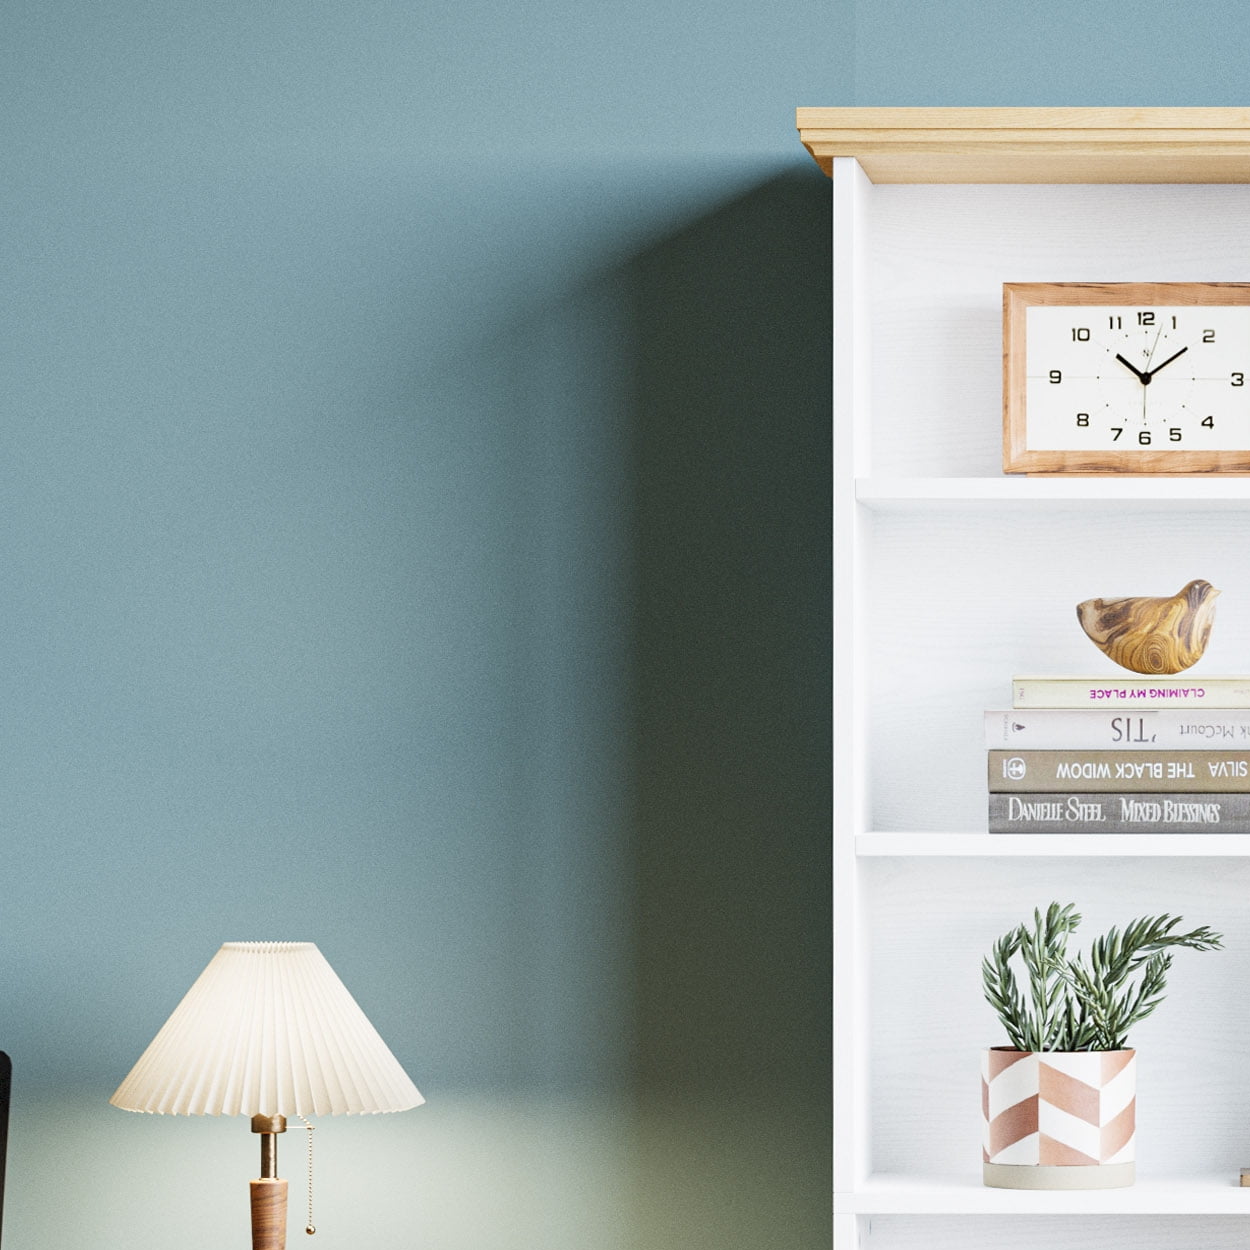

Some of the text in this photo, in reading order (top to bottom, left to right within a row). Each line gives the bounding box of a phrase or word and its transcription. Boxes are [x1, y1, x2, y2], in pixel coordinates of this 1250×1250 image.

[1109, 316, 1122, 329] 11
[1137, 312, 1155, 325] 12
[1171, 316, 1177, 329] 1
[1071, 328, 1090, 341] 10
[1202, 329, 1215, 343] 2
[1049, 370, 1061, 384] 9
[1231, 372, 1244, 386] 3
[1076, 413, 1089, 427] 8
[1201, 416, 1214, 429] 4
[1110, 428, 1123, 441] 7
[1138, 431, 1151, 445] 6
[1169, 428, 1182, 442] 5
[1089, 688, 1205, 699] CLAIMING MY PLACE
[1111, 717, 1157, 743] 'TIS
[1179, 724, 1235, 738] McCourt
[1056, 762, 1195, 779] THE BLACK WIDOW
[1208, 761, 1248, 777] SILVA
[1008, 796, 1106, 822] DANIELLE STEEL
[1119, 797, 1221, 824] MIXED BLESSINGS
